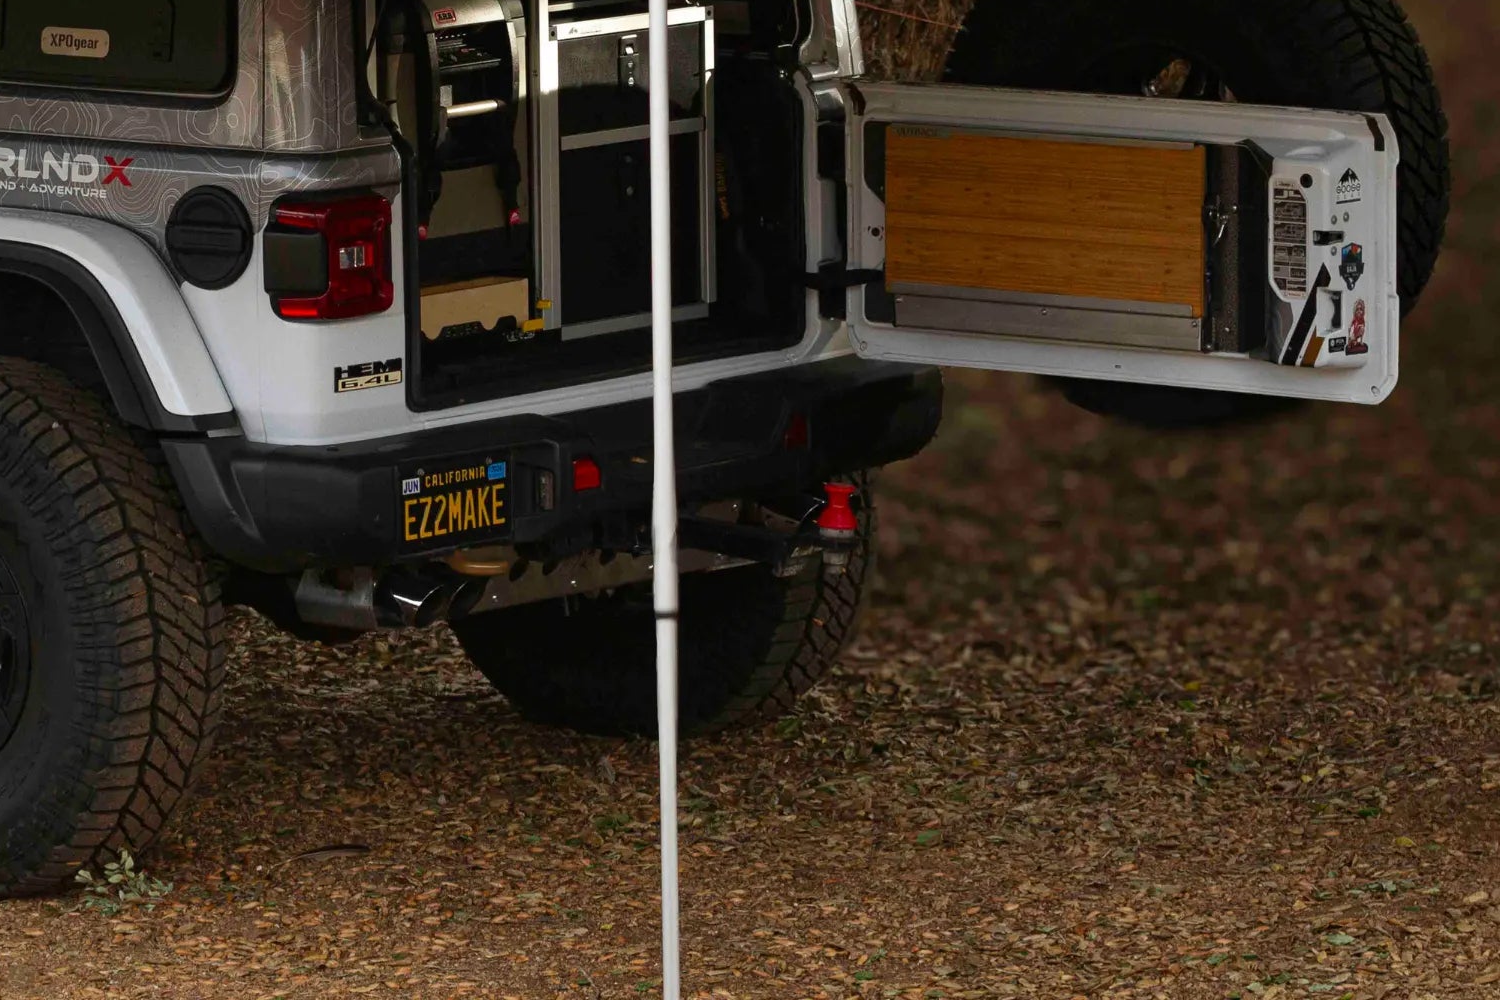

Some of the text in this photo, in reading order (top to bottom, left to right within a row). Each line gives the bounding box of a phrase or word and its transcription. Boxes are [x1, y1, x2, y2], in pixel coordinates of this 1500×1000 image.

[50, 33, 100, 51] XPOgear
[28, 182, 108, 199] ADVENTURE
[341, 374, 400, 389] 6.4L
[403, 480, 420, 494] JUN
[424, 465, 486, 489] CALIFORNIA
[404, 482, 506, 541] EZ2MAKE
